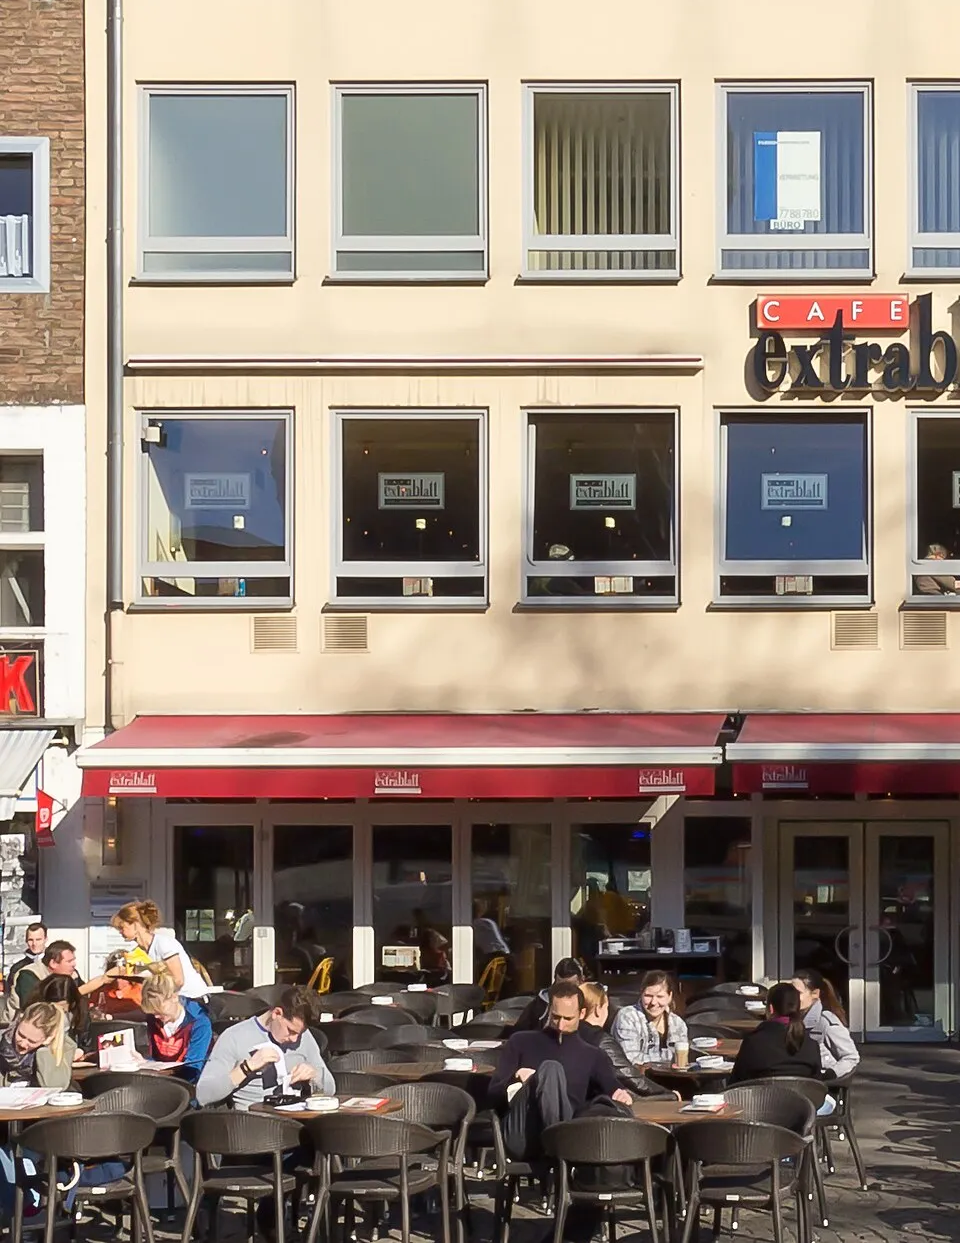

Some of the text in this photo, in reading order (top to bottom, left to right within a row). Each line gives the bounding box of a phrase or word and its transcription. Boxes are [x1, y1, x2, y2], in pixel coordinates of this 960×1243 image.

[763, 300, 903, 322] CAFE
[576, 480, 629, 498] extrablatt
[767, 479, 821, 498] extrablatt
[109, 771, 155, 786] extrablatt
[375, 771, 419, 787] extrablatt
[639, 769, 684, 785] extrablatt
